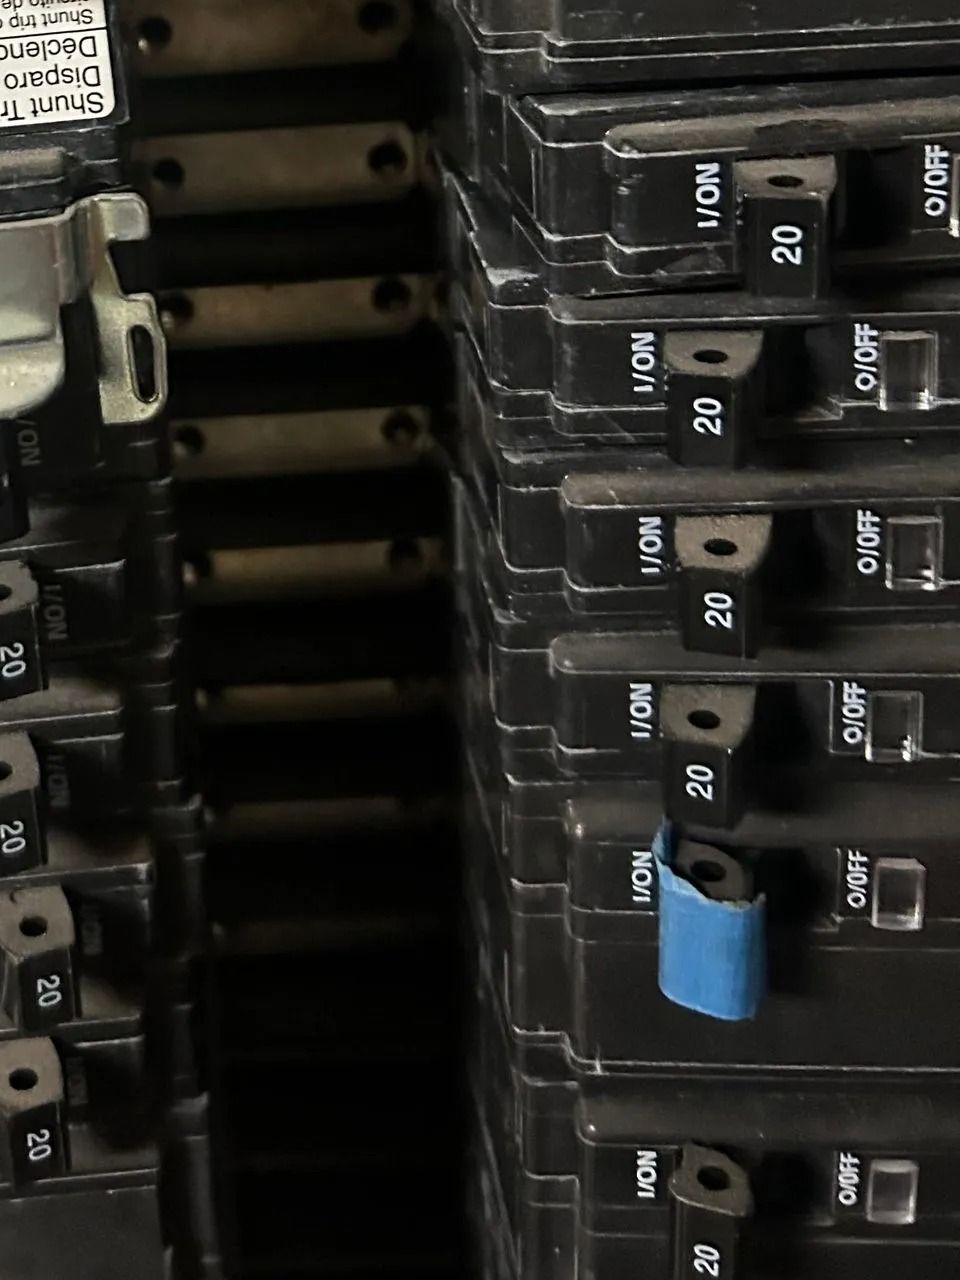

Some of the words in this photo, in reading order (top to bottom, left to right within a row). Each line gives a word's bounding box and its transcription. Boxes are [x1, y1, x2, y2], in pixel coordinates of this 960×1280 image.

[7, 11, 37, 31] trip
[39, 8, 94, 27] Shunt
[2, 62, 101, 90] Disparo
[28, 91, 104, 117] Shunt
[696, 162, 721, 229] I/ON
[925, 144, 950, 217] O/OFF
[771, 225, 804, 266] 20
[632, 331, 656, 393] I/ON
[854, 323, 879, 392] O/OFF
[694, 397, 722, 436] 20
[640, 516, 665, 575] I/ON
[857, 509, 880, 574] O/OFF
[704, 592, 734, 629] 20
[0, 644, 25, 678] 20
[630, 683, 652, 739] I/ON
[843, 681, 866, 744] O/OFF
[686, 764, 714, 801] 20
[0, 820, 26, 855] 20
[633, 851, 652, 903] I/ON
[847, 851, 868, 908] O/OFF
[36, 975, 62, 1008] 20
[26, 1128, 51, 1161] 20
[638, 1151, 657, 1199] I/ON
[839, 1153, 861, 1205] O/OFF
[695, 1244, 719, 1279] 20
